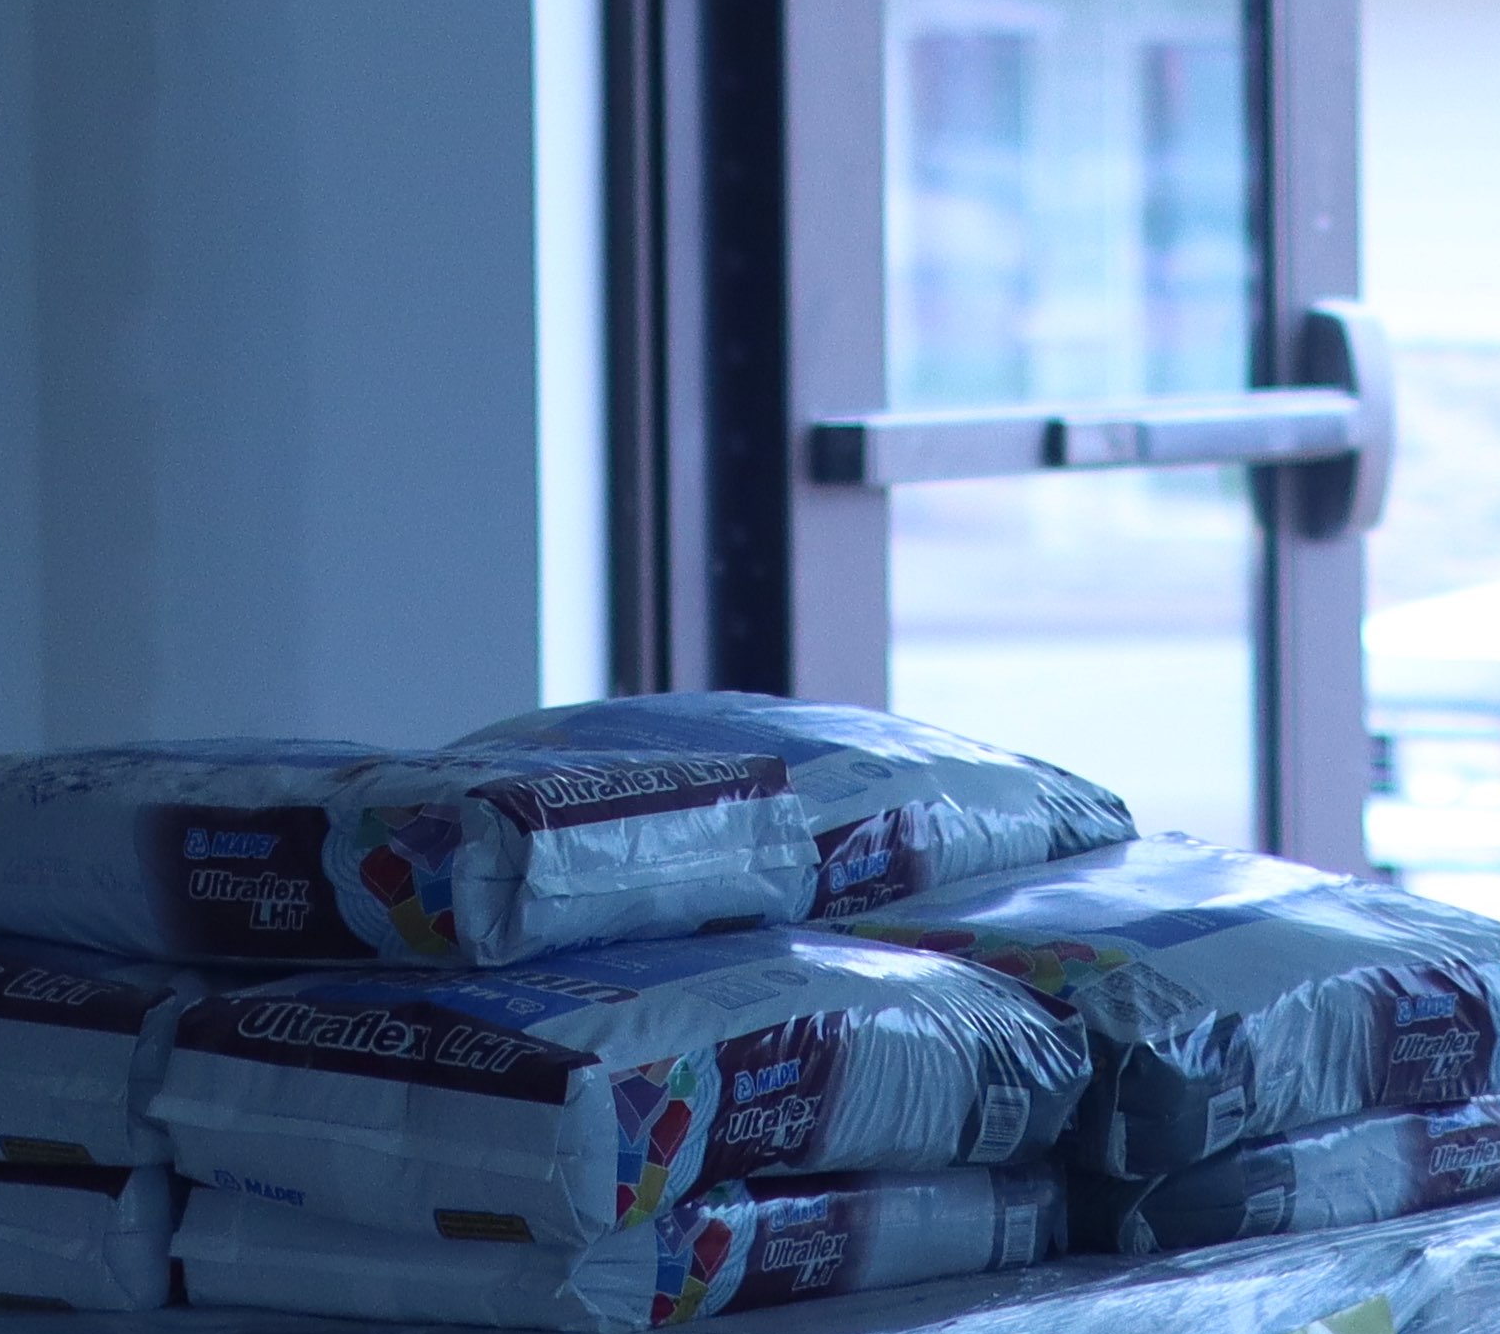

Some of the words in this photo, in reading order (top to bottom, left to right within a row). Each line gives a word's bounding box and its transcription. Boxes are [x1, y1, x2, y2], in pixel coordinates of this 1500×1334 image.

[532, 765, 678, 809] Ultraflex
[210, 831, 280, 861] MAPEI
[188, 869, 310, 905] Ultraflex
[249, 900, 311, 931] LHT
[3, 969, 120, 1007] LHT
[236, 1001, 436, 1061] Ultraflex
[433, 1024, 550, 1074] LHT
[1390, 1027, 1480, 1064] Ultraflex
[725, 1094, 822, 1145] Ultraflex
[243, 1174, 306, 1208] MAPEI
[761, 1230, 849, 1272] Ultraflex
